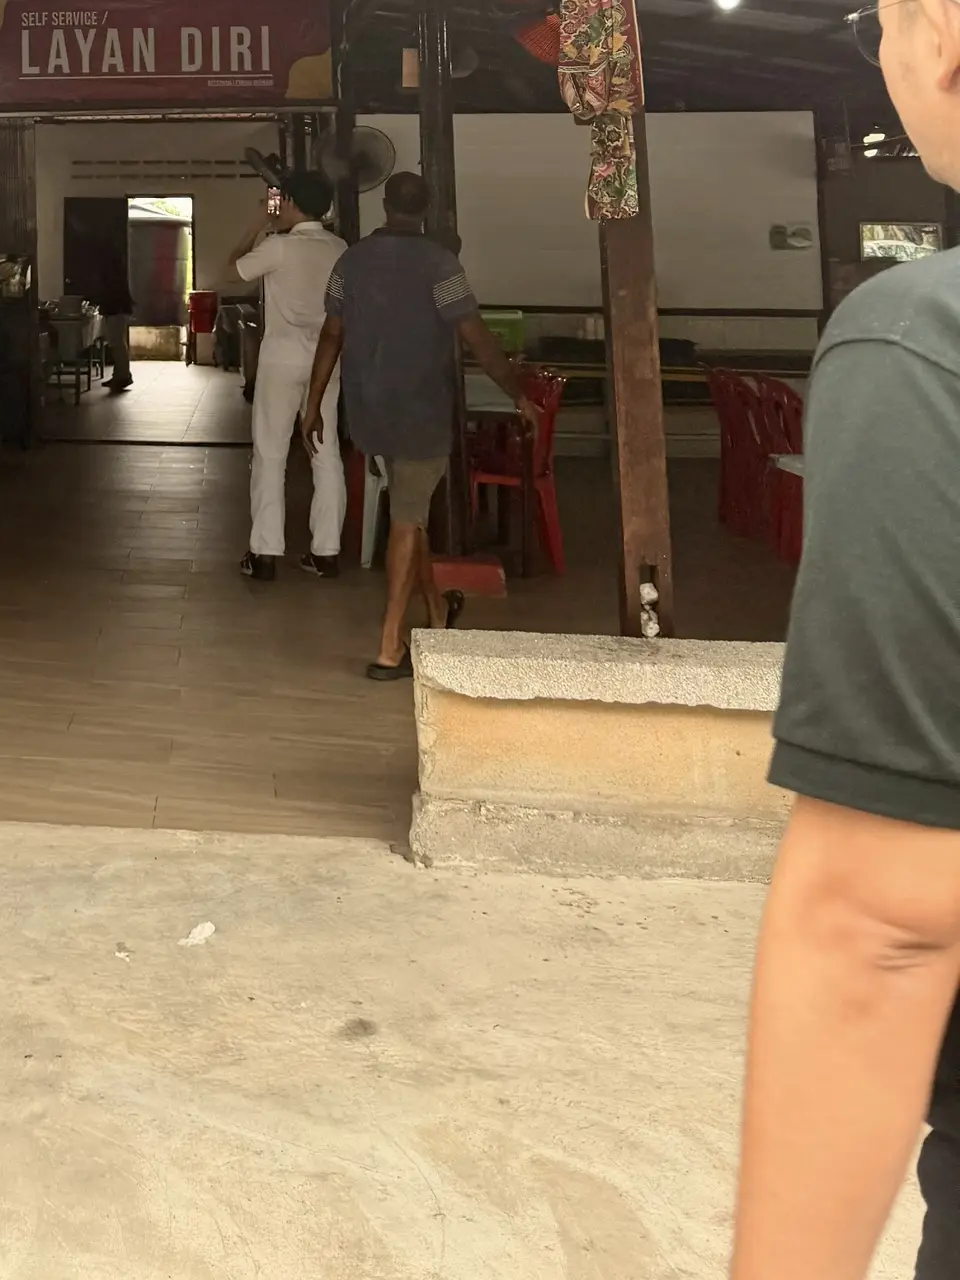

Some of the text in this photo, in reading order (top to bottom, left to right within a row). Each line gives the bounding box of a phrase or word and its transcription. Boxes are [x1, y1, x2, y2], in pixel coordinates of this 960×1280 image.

[21, 12, 49, 27] SELF
[51, 11, 98, 26] SERVICE
[21, 25, 271, 74] LAYAN DIRI
